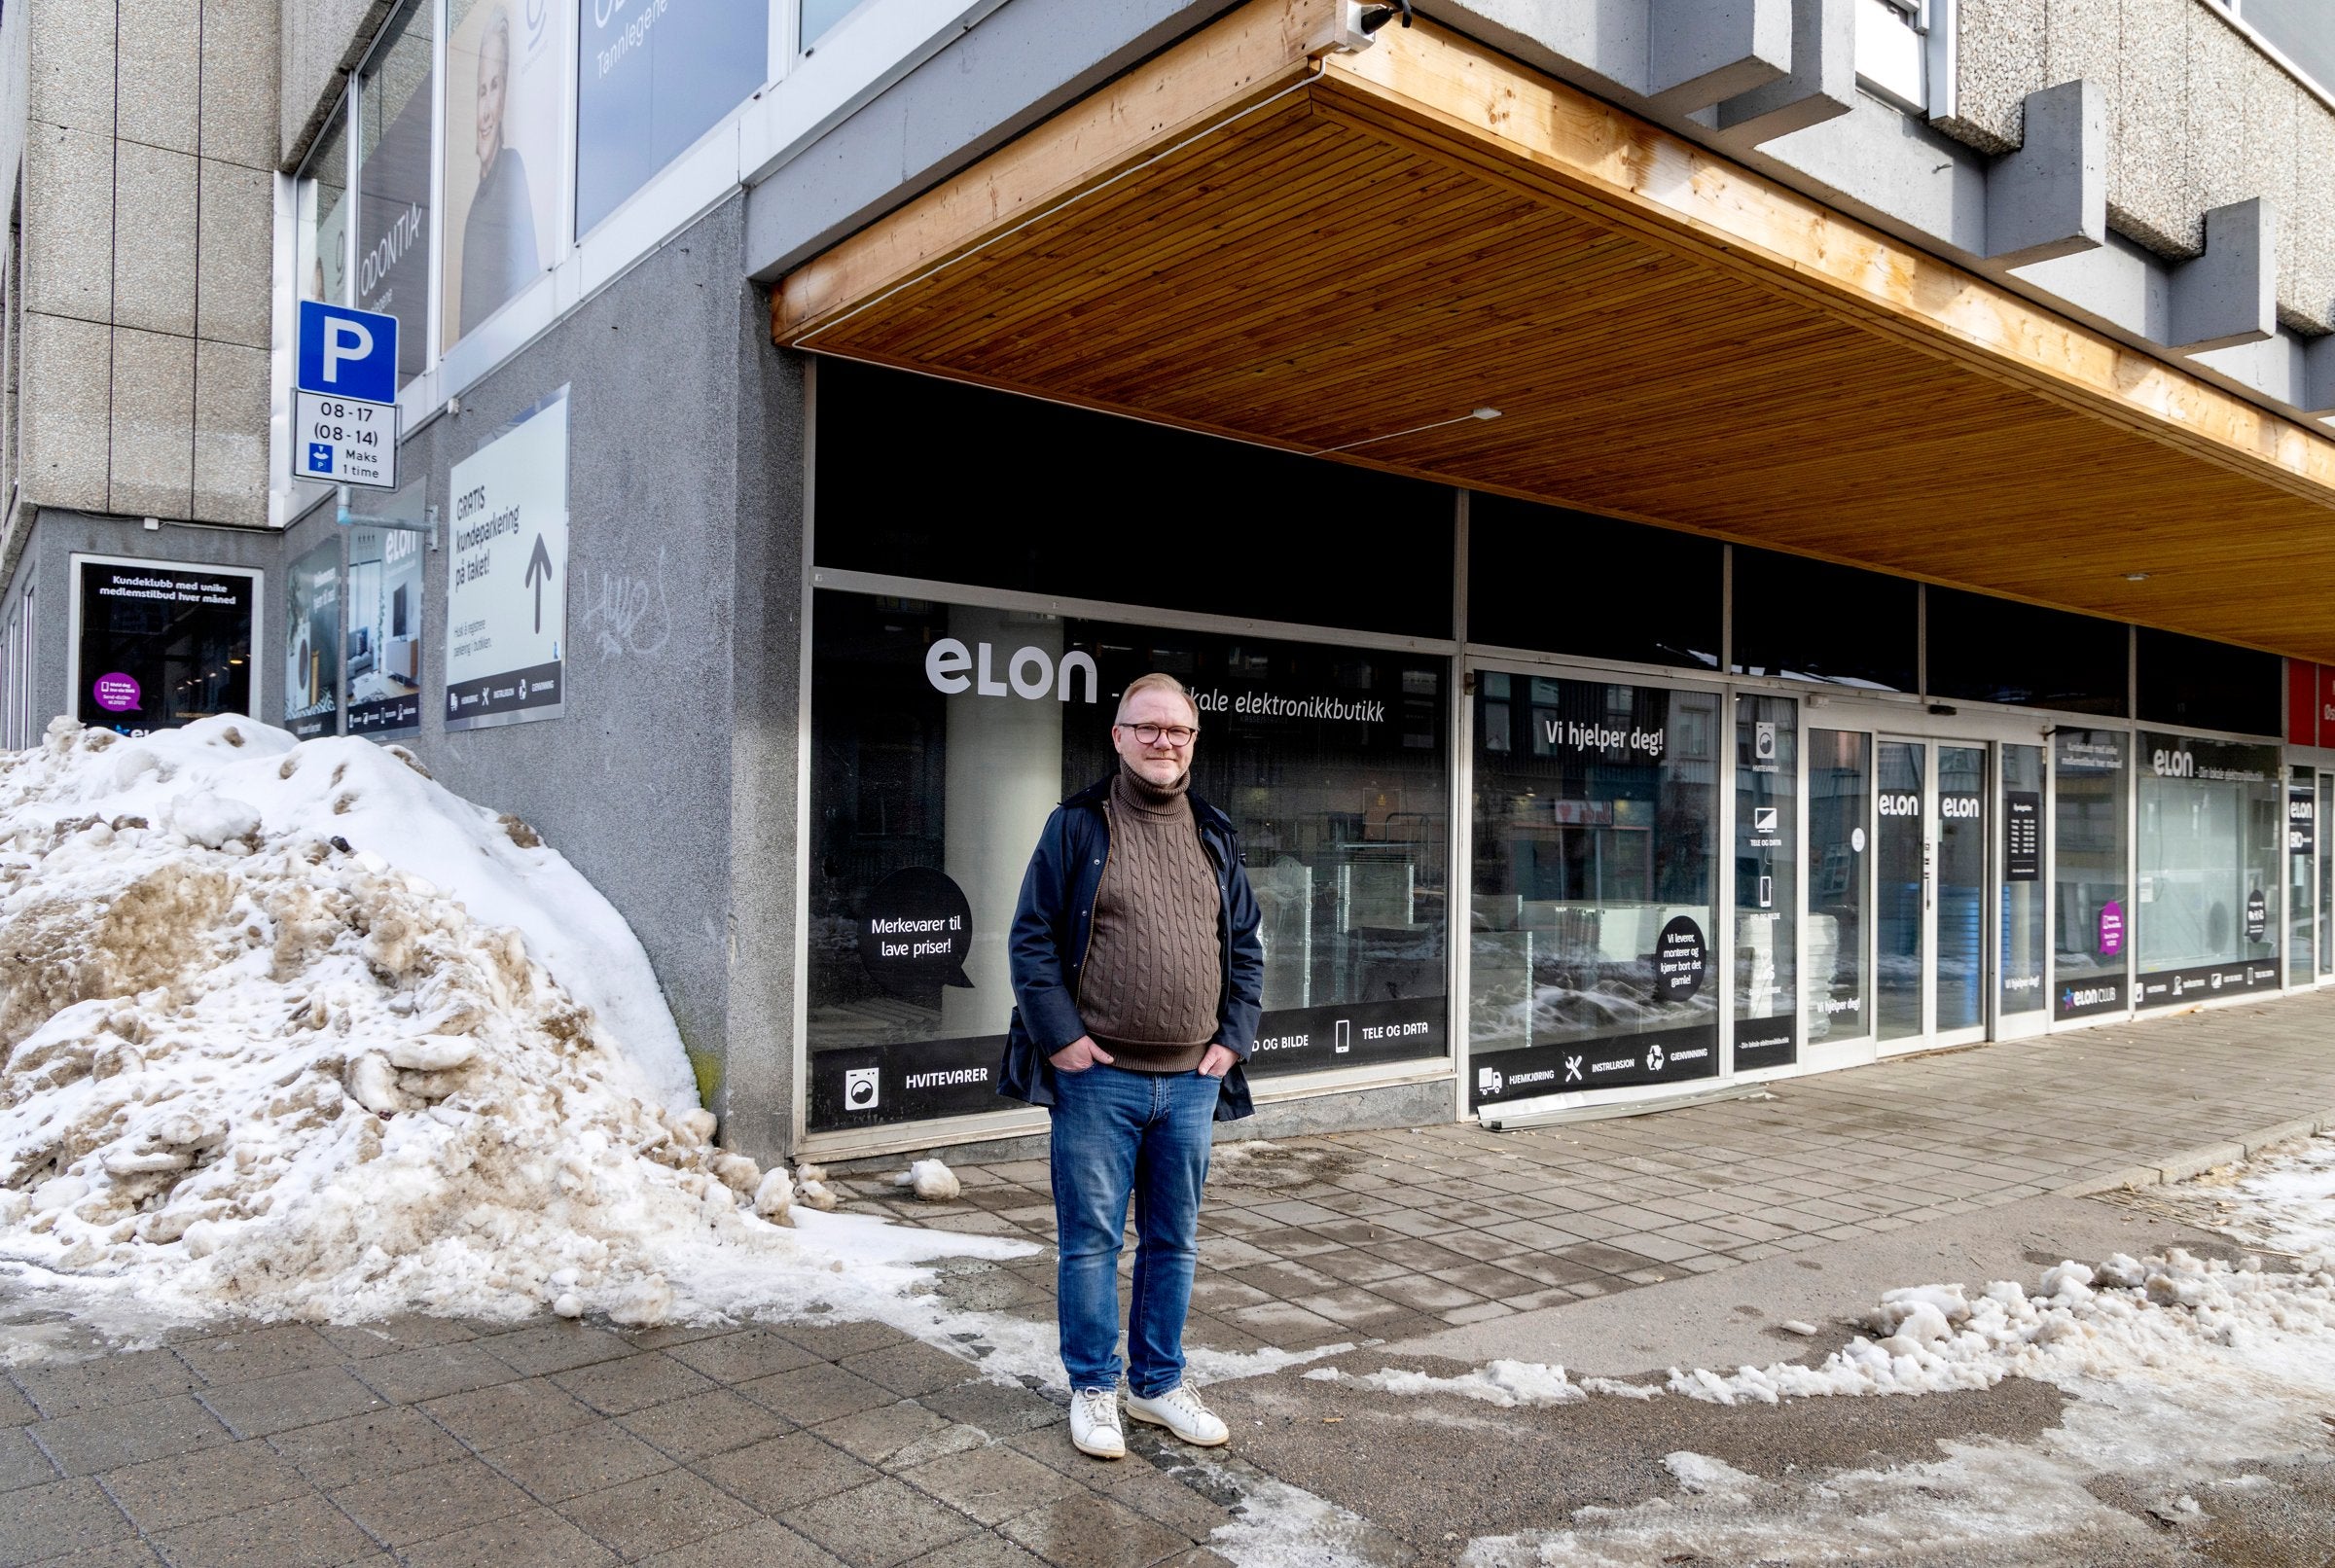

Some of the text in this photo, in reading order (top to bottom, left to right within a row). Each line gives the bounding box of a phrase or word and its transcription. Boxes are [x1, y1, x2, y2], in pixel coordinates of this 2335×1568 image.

[597, 0, 667, 79] Tannlegene
[361, 202, 421, 296] ODONTIA
[323, 316, 374, 383] P
[345, 449, 377, 463] Maks
[343, 464, 378, 478] 1 time
[457, 485, 485, 521] GRATIS
[456, 504, 520, 553] kundeparkering
[455, 558, 465, 593] på
[467, 548, 490, 582] taket!
[113, 575, 228, 593] Kundeklubb med unike
[99, 588, 236, 604] medlemstilbud hver måned
[1190, 687, 1228, 712] kale
[1236, 691, 1385, 723] elektronikkbutikk
[1545, 720, 1664, 757] Vi hjelper deg!
[872, 914, 961, 934] Merkevarer til
[881, 938, 952, 958] lave priser!
[1668, 934, 1673, 944] Vi
[1663, 947, 1699, 958] monterer og
[1660, 960, 1702, 975] kjører bort det
[1670, 975, 1691, 987] gamle!
[1362, 1021, 1428, 1040] TELE OG DATA
[1263, 1038, 1278, 1051] OG
[1281, 1035, 1309, 1049] BILDE
[1670, 1048, 1708, 1061] GJENVINNING
[1592, 1058, 1634, 1073] INSTALLASJON
[906, 1068, 988, 1088] HVITEVARER
[1509, 1070, 1555, 1085] HJEMKJØRING
